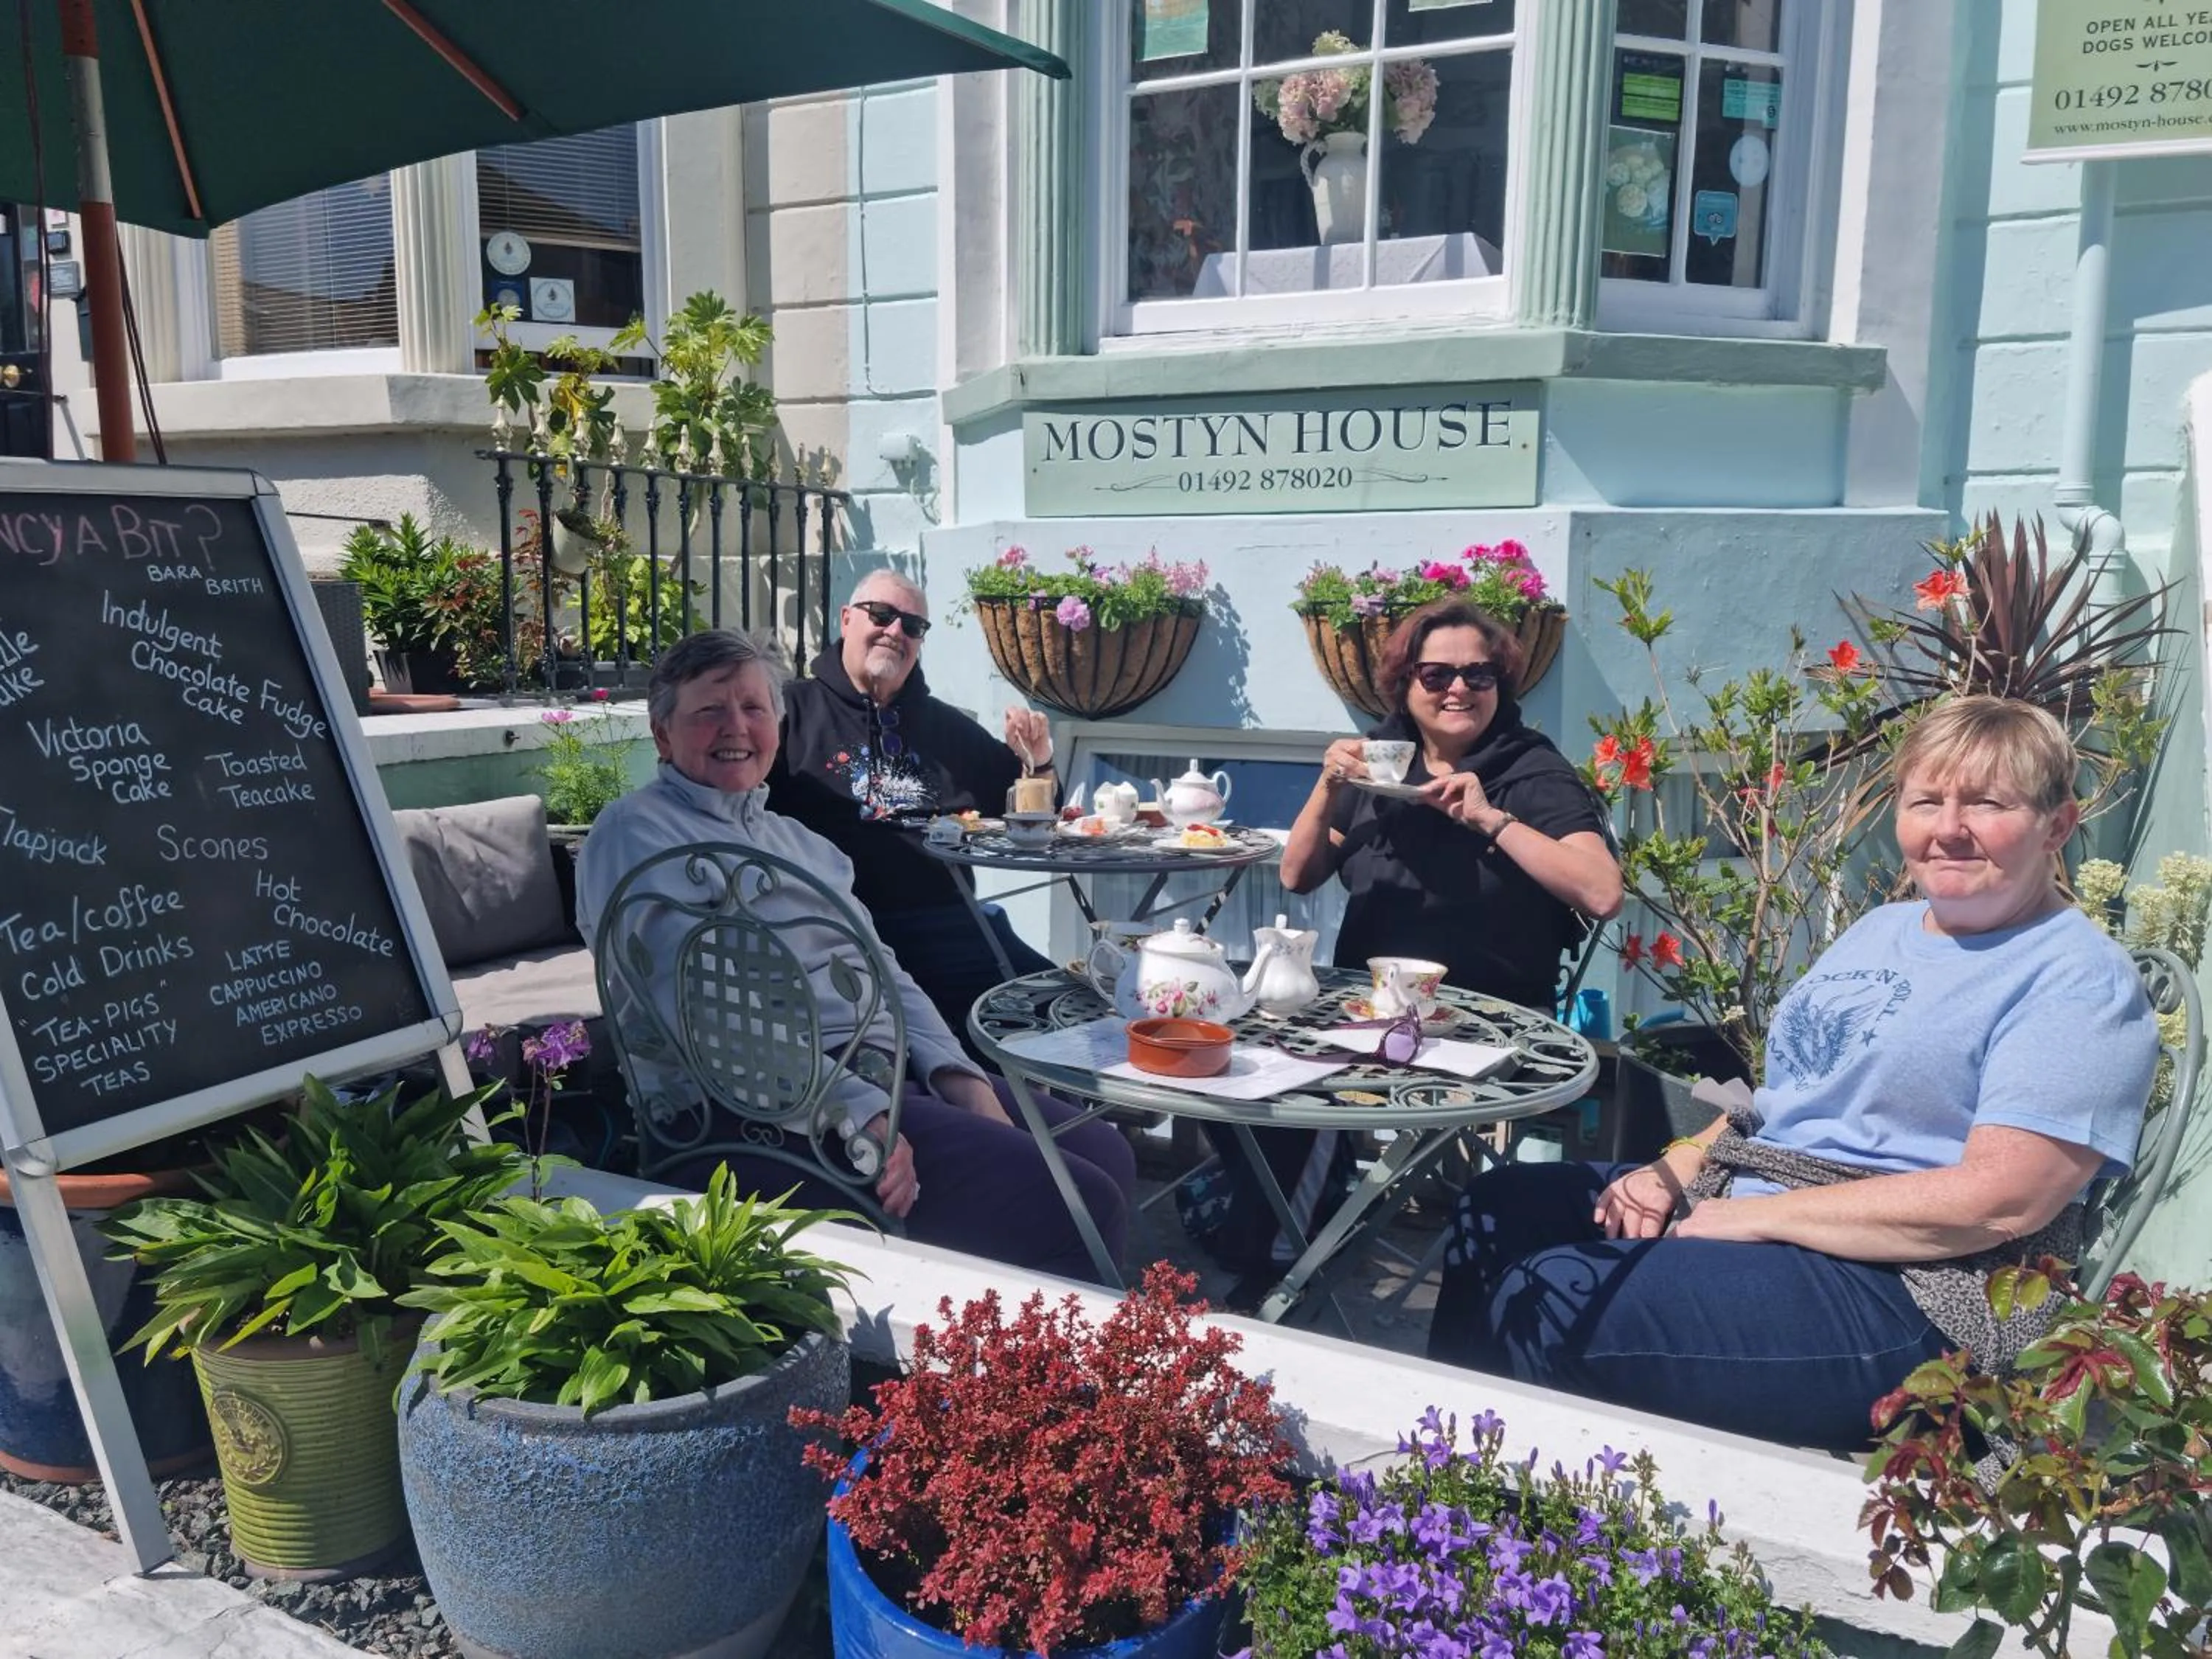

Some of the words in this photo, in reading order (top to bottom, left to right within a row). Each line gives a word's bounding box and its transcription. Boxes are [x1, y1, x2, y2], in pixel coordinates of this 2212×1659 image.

[2086, 18, 2136, 35] OPEN
[2143, 14, 2179, 29] ALL
[2186, 10, 2212, 26] YE
[2082, 38, 2134, 54] DOGS
[2142, 31, 2212, 49] WELCO
[2054, 84, 2140, 111] 01492
[1042, 414, 1270, 462] MOSTYN
[1293, 400, 1512, 453] HOUSE
[1178, 470, 1253, 493] 01492
[1259, 467, 1354, 491] 878020
[76, 514, 108, 554] A
[147, 565, 204, 582] BARA
[206, 576, 264, 596] BRITH
[102, 590, 223, 659] Indulgent
[131, 640, 251, 704] Chocolate
[260, 678, 329, 740] Fudge
[181, 686, 245, 726] Cake
[27, 718, 150, 759] Victoria
[69, 751, 173, 791] Sponge
[204, 744, 307, 778] Toasted
[111, 778, 173, 804] Cake
[218, 778, 316, 808] Teacake
[156, 824, 269, 862] Scones
[254, 869, 301, 902] Hot
[274, 904, 394, 957] Chocolate
[21, 960, 86, 1001] Cold
[99, 933, 195, 978] Drinks
[224, 939, 291, 973] LATTE
[208, 961, 323, 1006] CAPPUCCINO
[235, 983, 338, 1026] AMERICANO
[260, 1004, 363, 1046] EXPRESSO
[33, 1018, 178, 1084] SPECIALITY
[80, 1060, 152, 1096] TEAS
